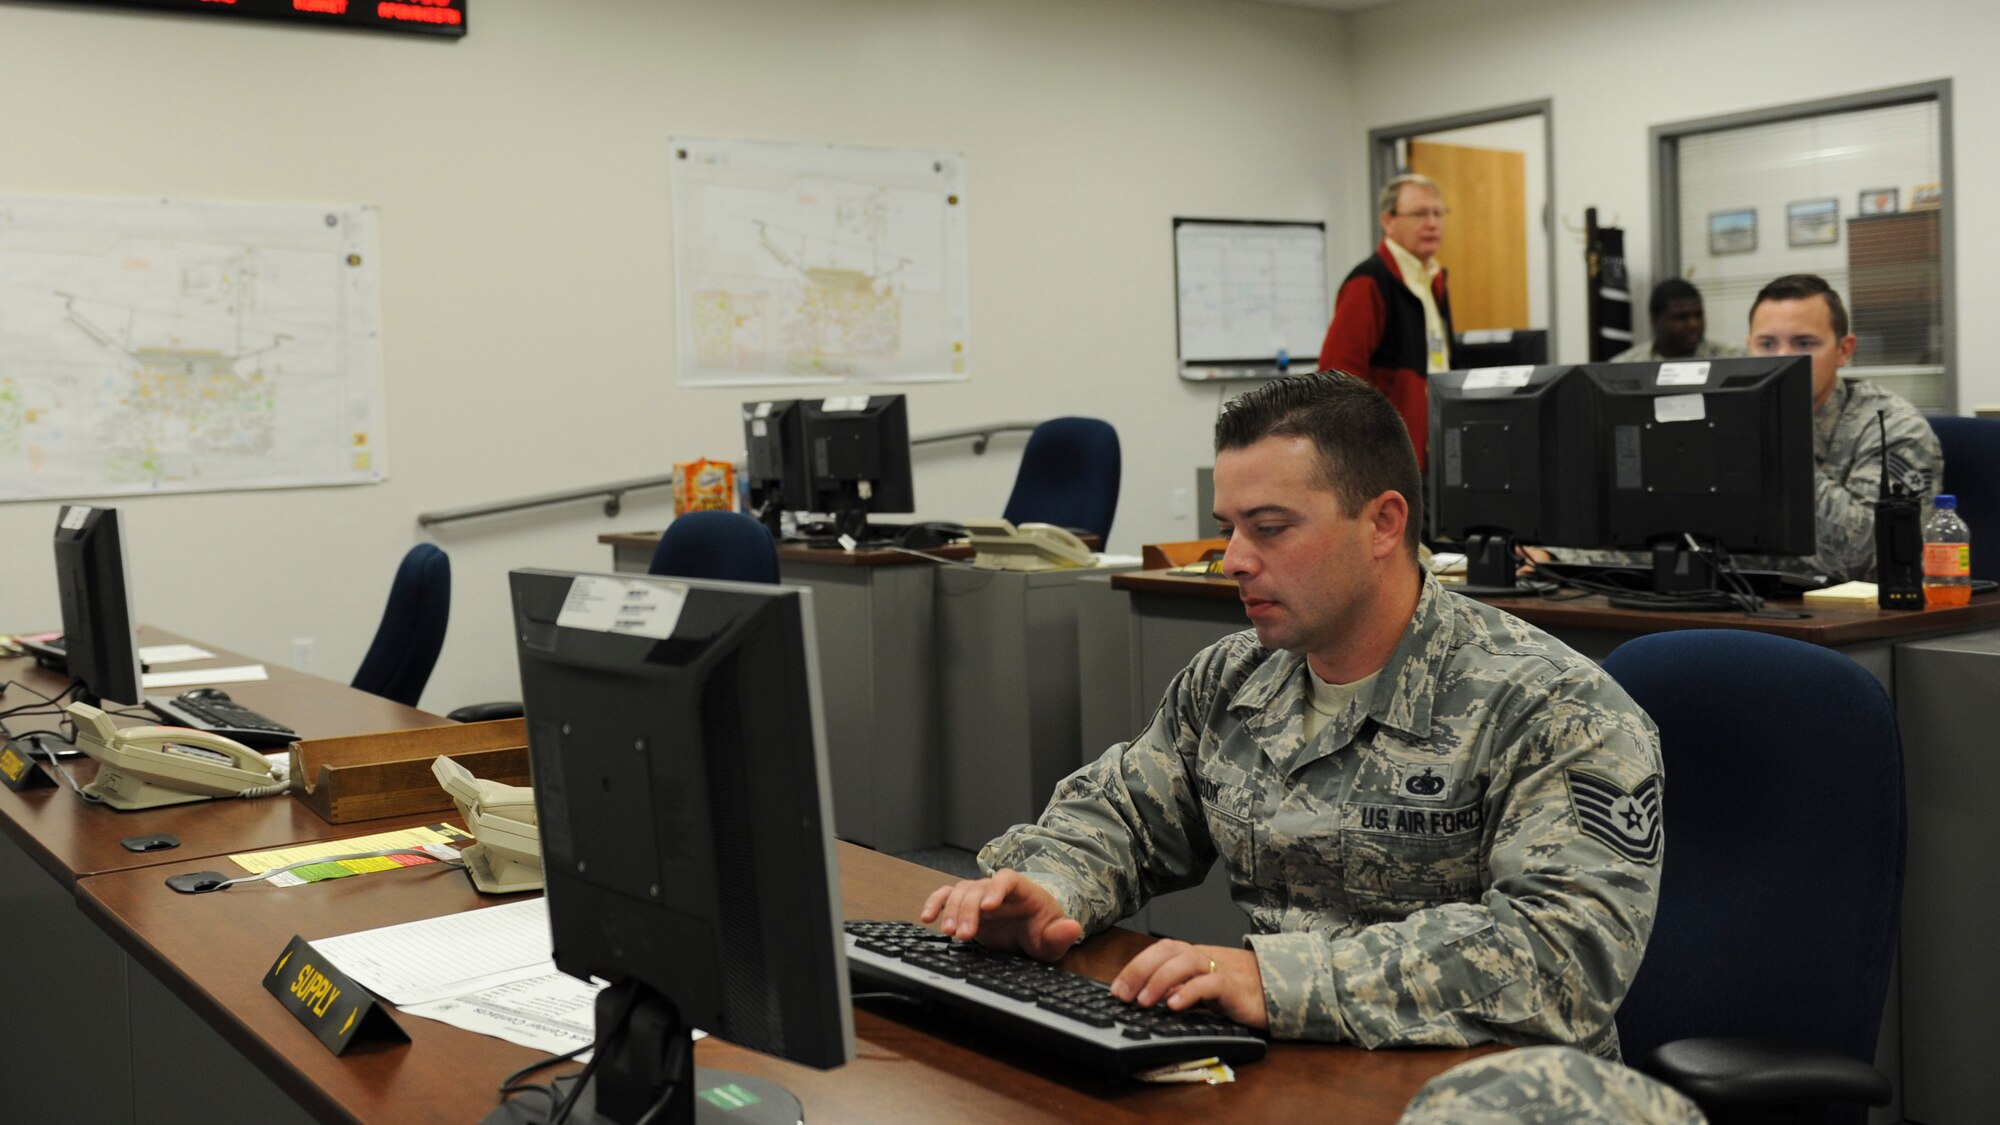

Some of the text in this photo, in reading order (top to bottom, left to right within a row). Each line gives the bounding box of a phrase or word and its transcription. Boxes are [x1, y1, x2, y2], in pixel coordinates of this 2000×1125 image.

[1361, 806, 1486, 834] U.S. AIR FORC
[290, 963, 341, 1019] SUPPLY
